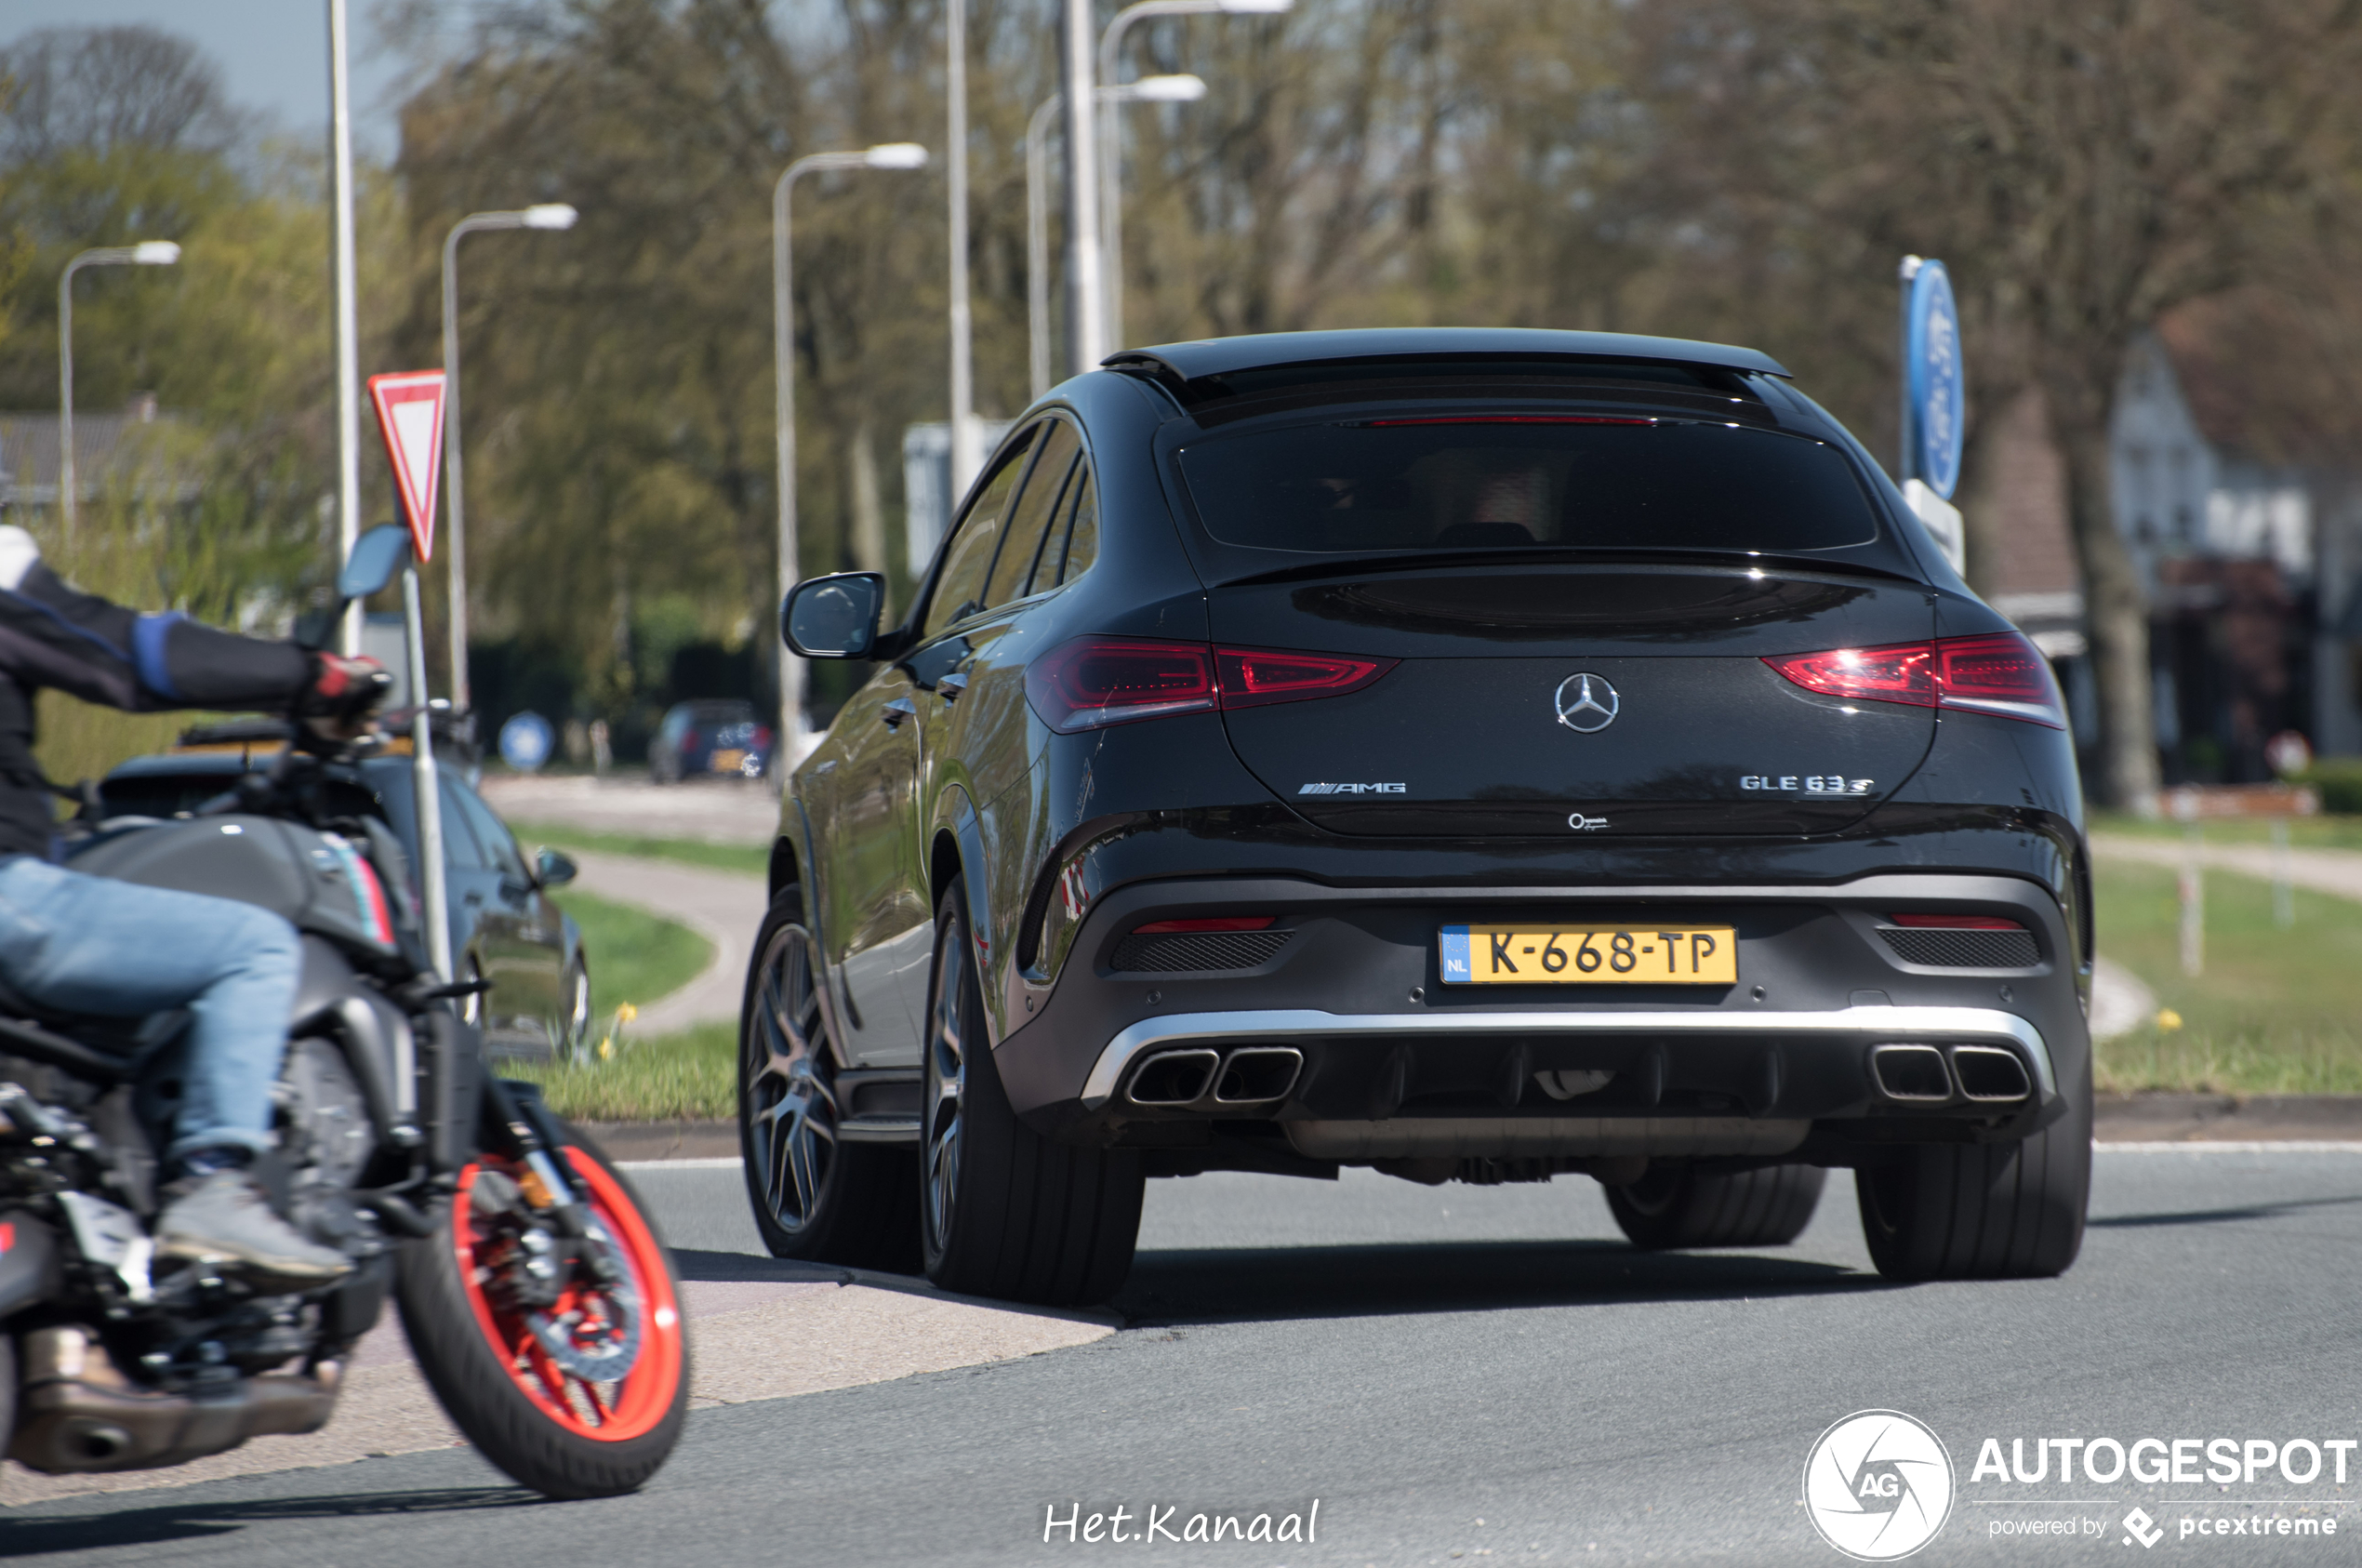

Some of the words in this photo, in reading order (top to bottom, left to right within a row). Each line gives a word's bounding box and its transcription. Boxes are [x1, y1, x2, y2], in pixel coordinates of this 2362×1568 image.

[1740, 775, 1798, 791] GLE
[1490, 931, 1716, 974] K-668-TP
[1444, 958, 1468, 973] NL
